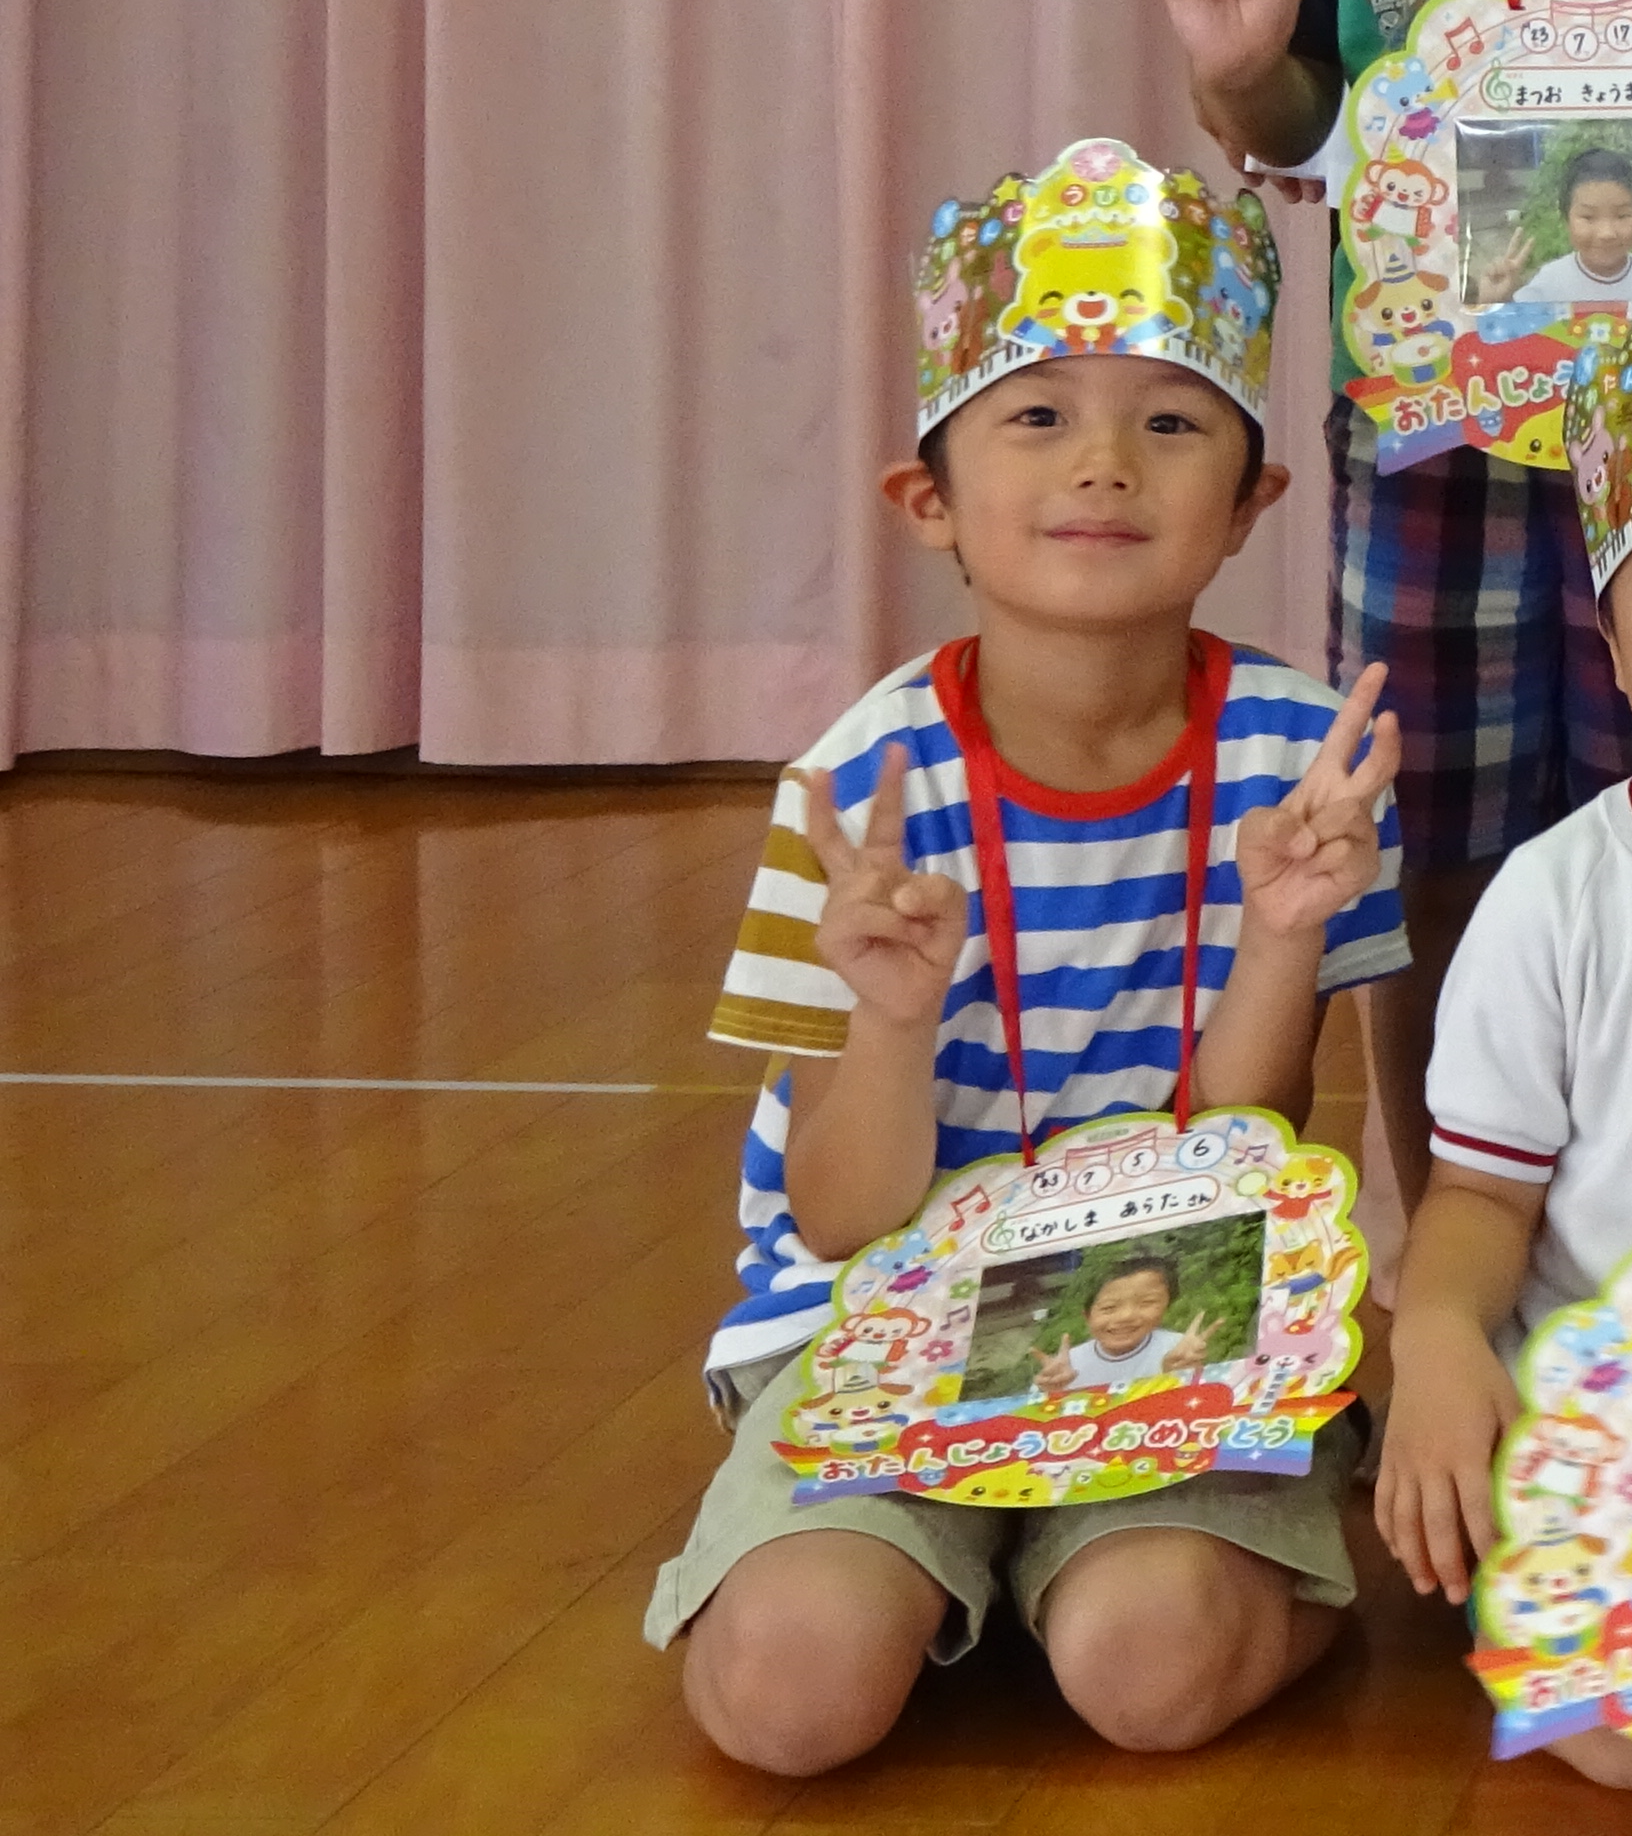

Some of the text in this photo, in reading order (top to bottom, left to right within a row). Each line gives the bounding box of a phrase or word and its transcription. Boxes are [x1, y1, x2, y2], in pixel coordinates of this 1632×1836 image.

[1573, 33, 1585, 53] 7
[1613, 25, 1630, 41] 17
[1515, 85, 1562, 105] まつお
[1193, 1139, 1209, 1156] 6
[818, 1414, 1298, 1483] おたんじょうび おめでとう
